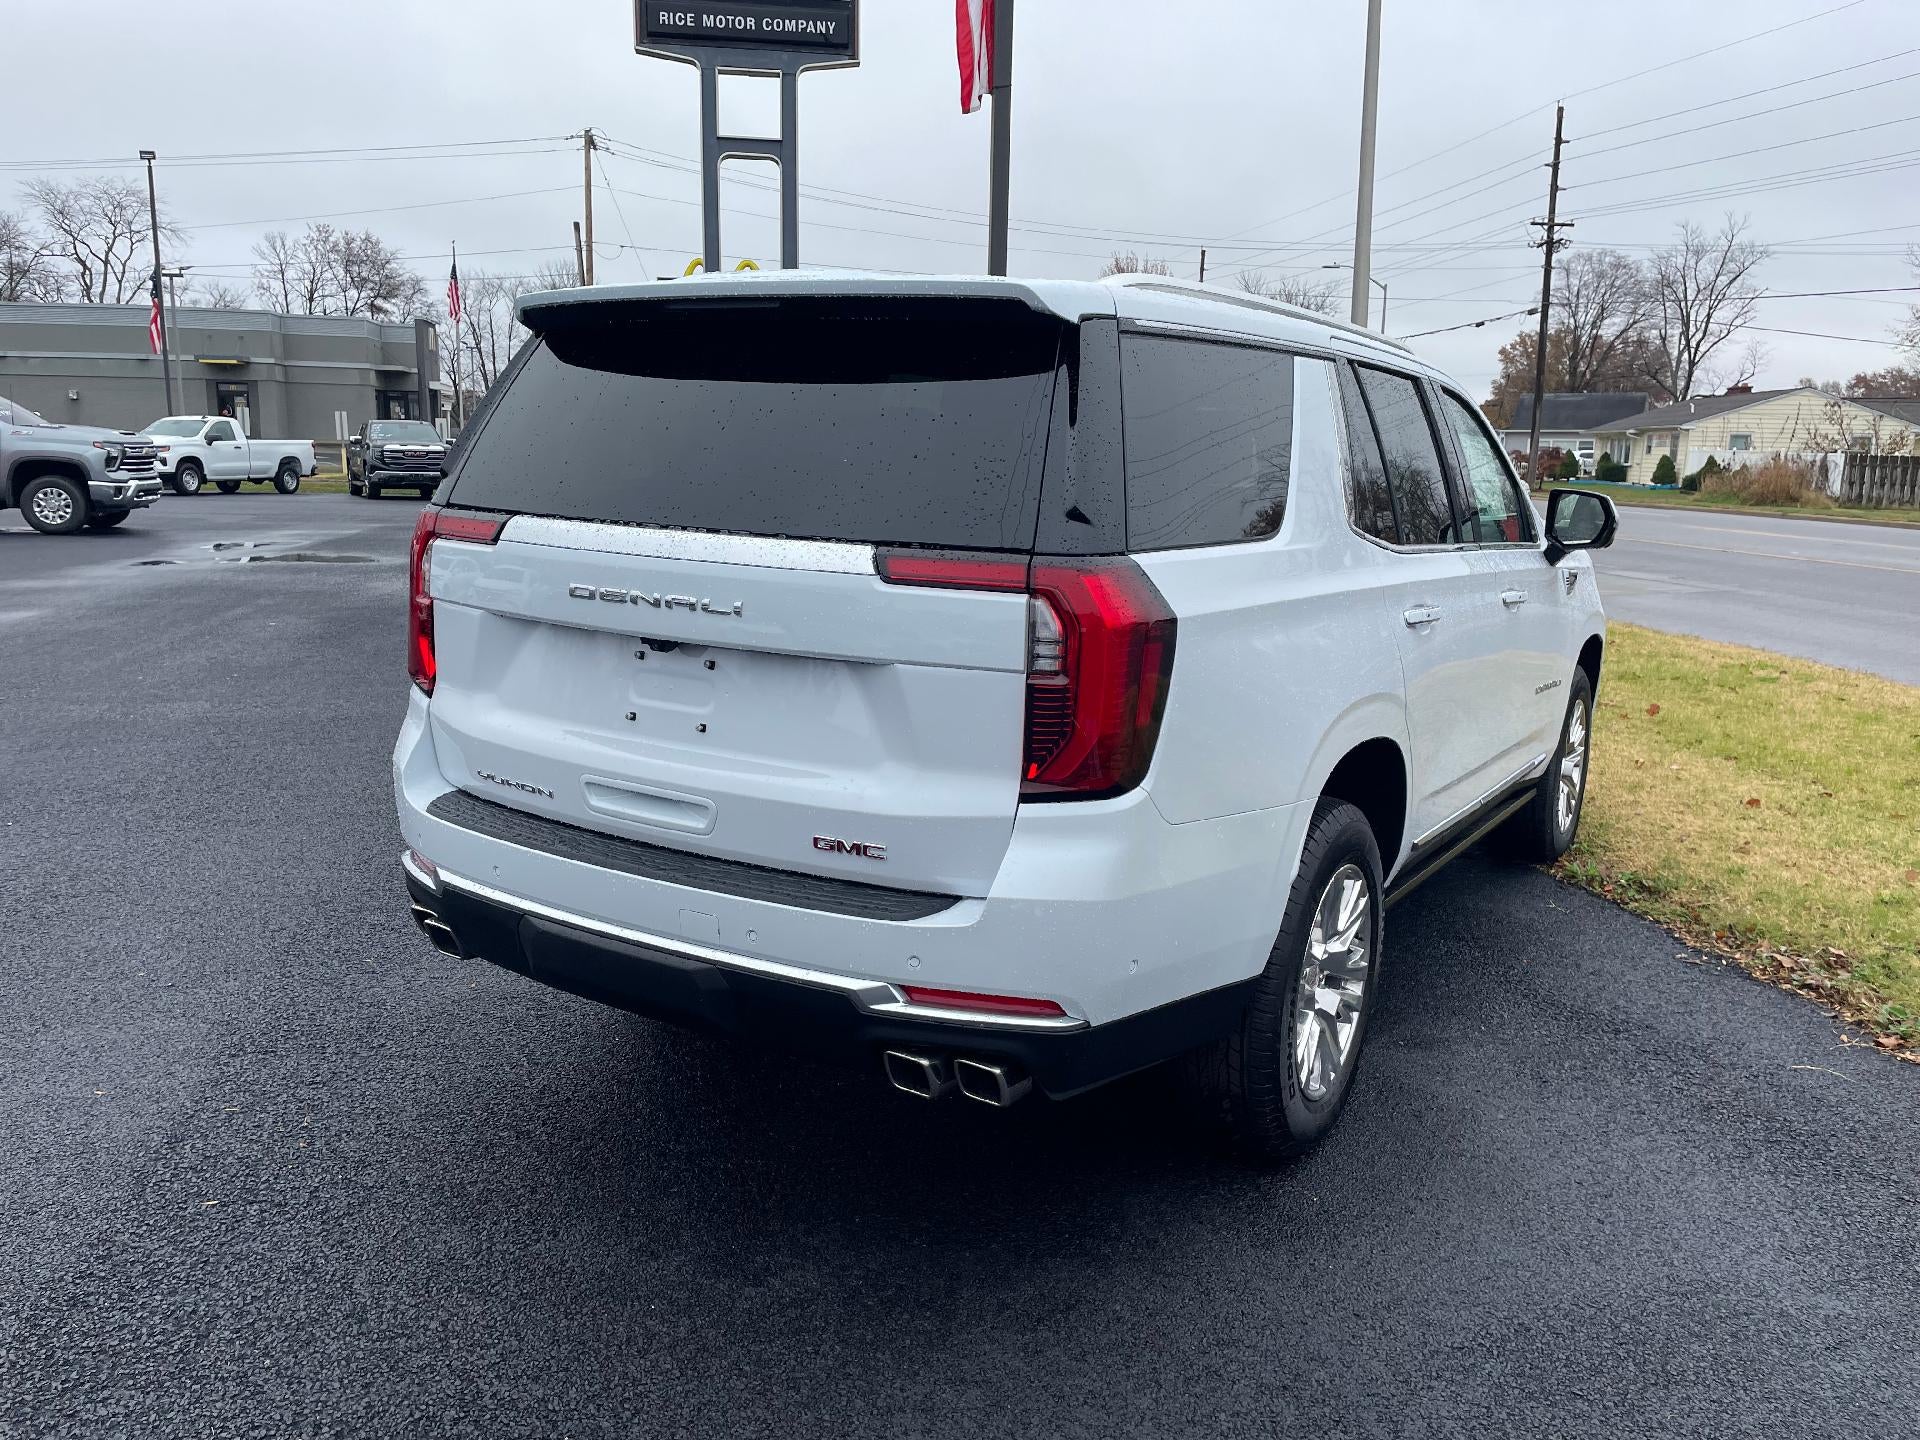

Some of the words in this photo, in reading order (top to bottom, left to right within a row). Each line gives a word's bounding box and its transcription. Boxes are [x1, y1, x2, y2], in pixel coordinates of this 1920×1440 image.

[659, 12, 695, 26] RICE
[702, 14, 755, 30] MOTOR
[763, 18, 836, 35] COMPANY
[568, 583, 743, 617] DENALI
[476, 769, 555, 799] YUKON
[813, 835, 887, 860] GMC
